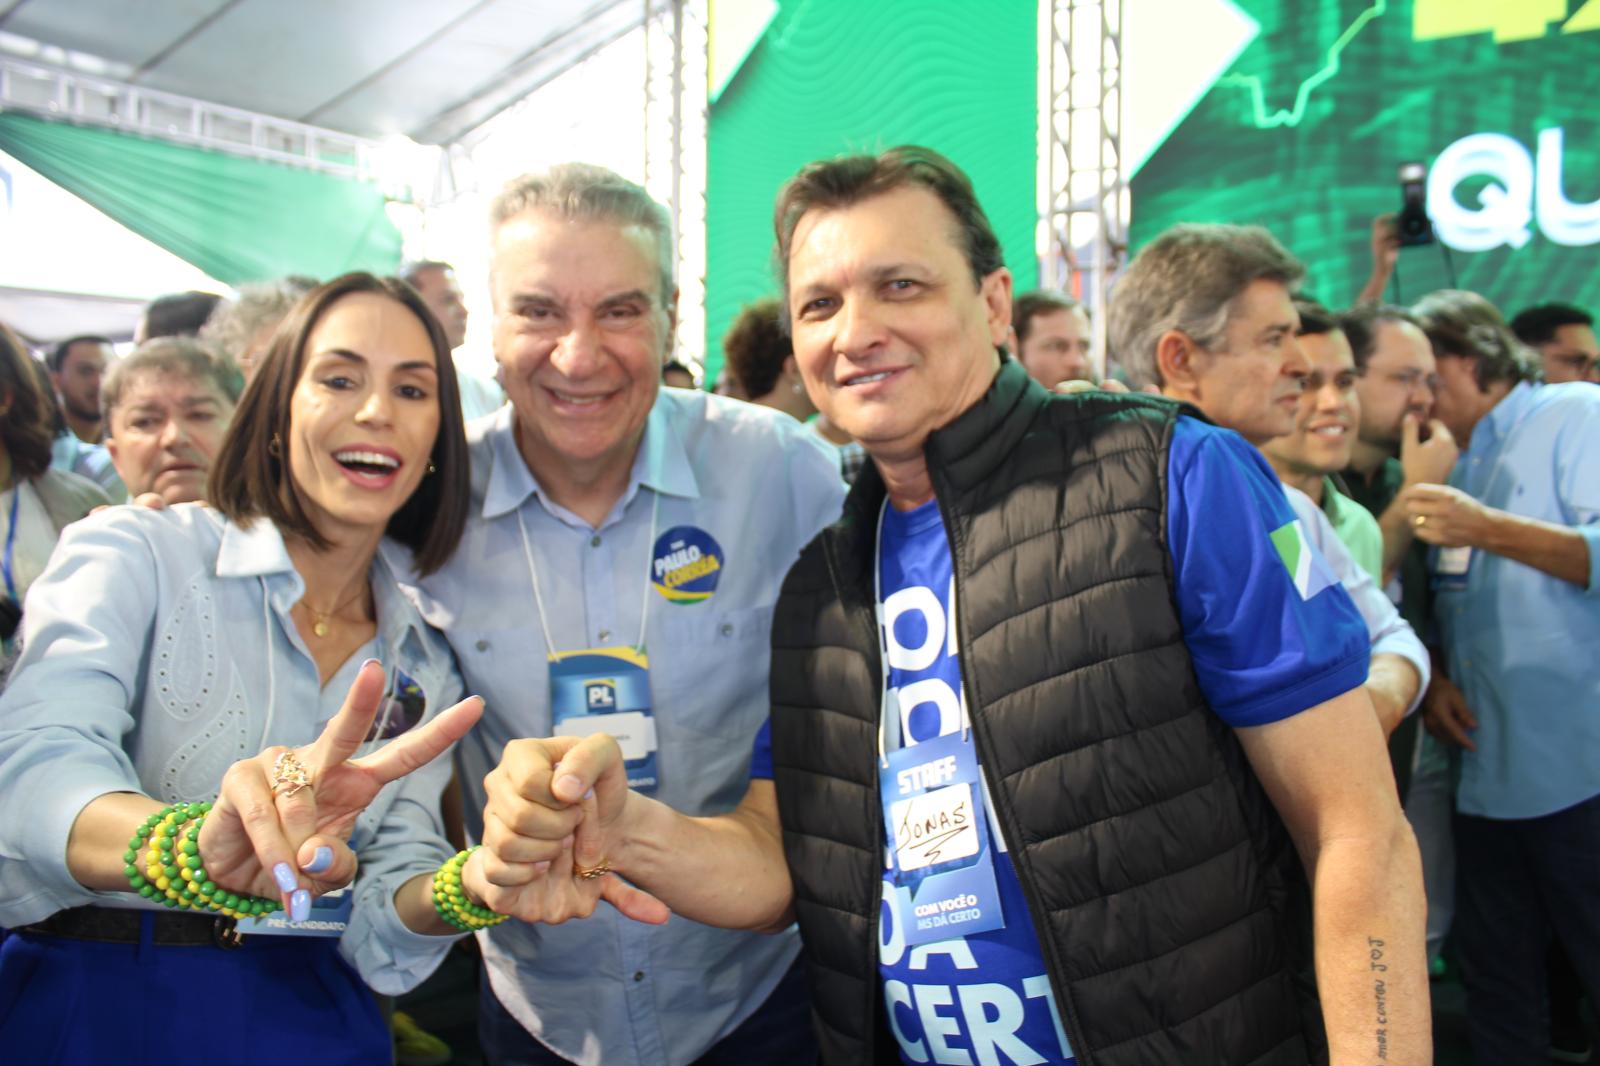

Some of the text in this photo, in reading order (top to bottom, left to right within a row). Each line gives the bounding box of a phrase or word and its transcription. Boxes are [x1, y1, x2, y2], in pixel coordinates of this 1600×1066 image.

[655, 545, 701, 577] PAULO
[589, 686, 613, 704] PL
[897, 755, 957, 795] STAFF
[896, 801, 966, 852] JONAS
[915, 894, 977, 917] COM VOCÊ O
[949, 908, 980, 924] CERTO
